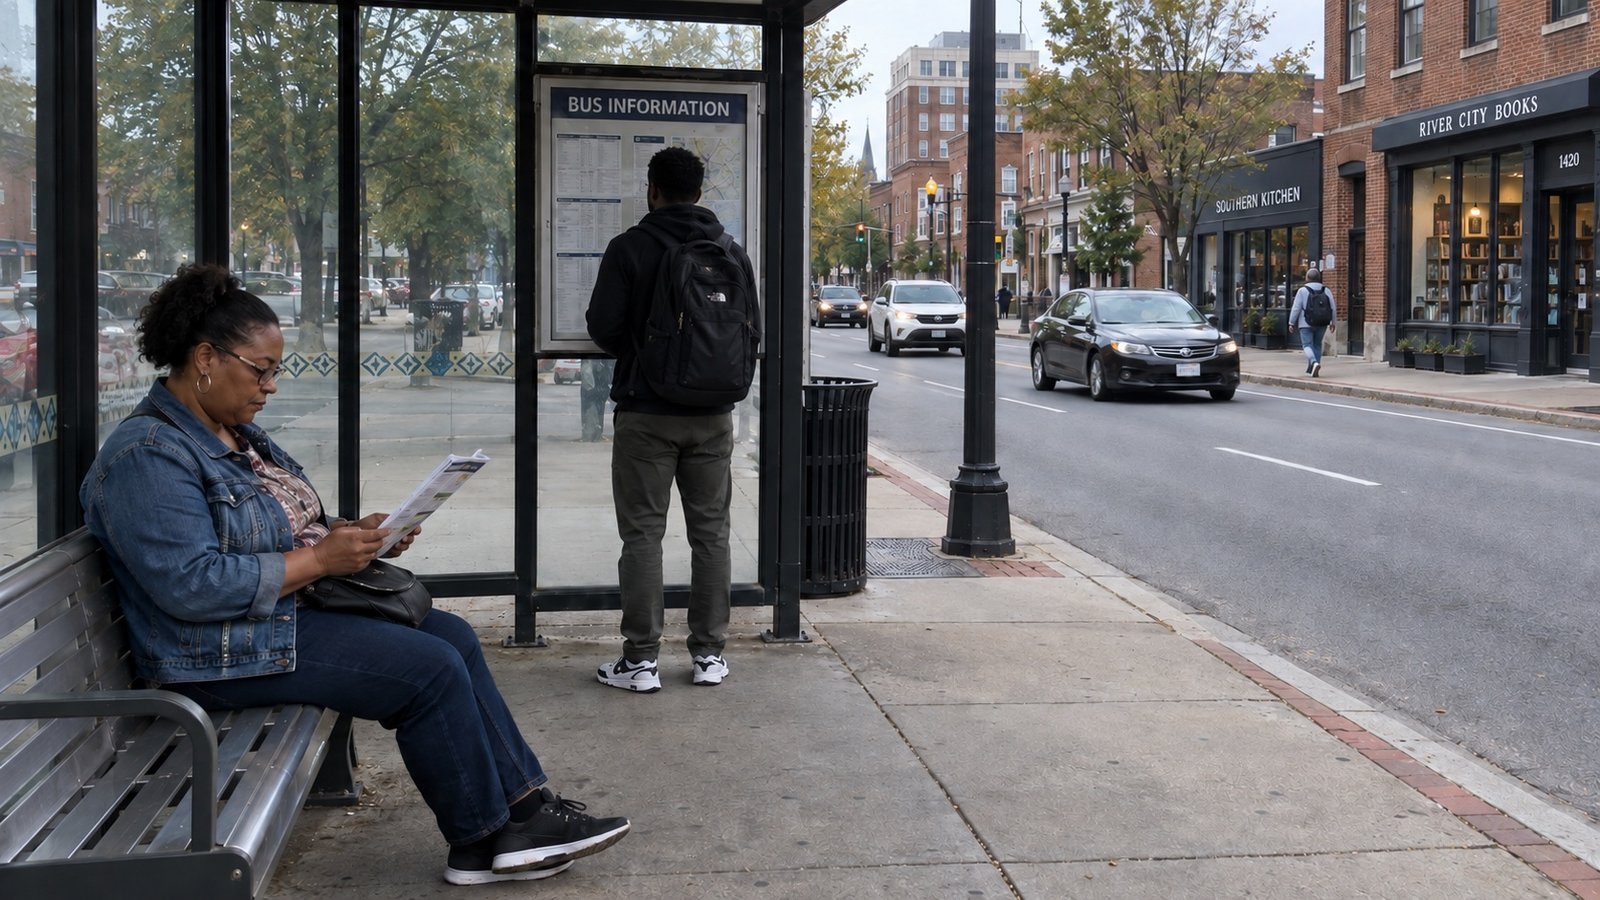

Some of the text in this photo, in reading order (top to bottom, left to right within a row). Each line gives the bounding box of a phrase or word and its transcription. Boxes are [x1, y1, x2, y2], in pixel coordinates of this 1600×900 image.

[568, 96, 730, 117] BUS INFORMATION
[1419, 95, 1538, 137] RIVER CITY BOOKS
[1558, 152, 1580, 169] 1420
[1215, 186, 1301, 213] SOUTHERN KITCHEN
